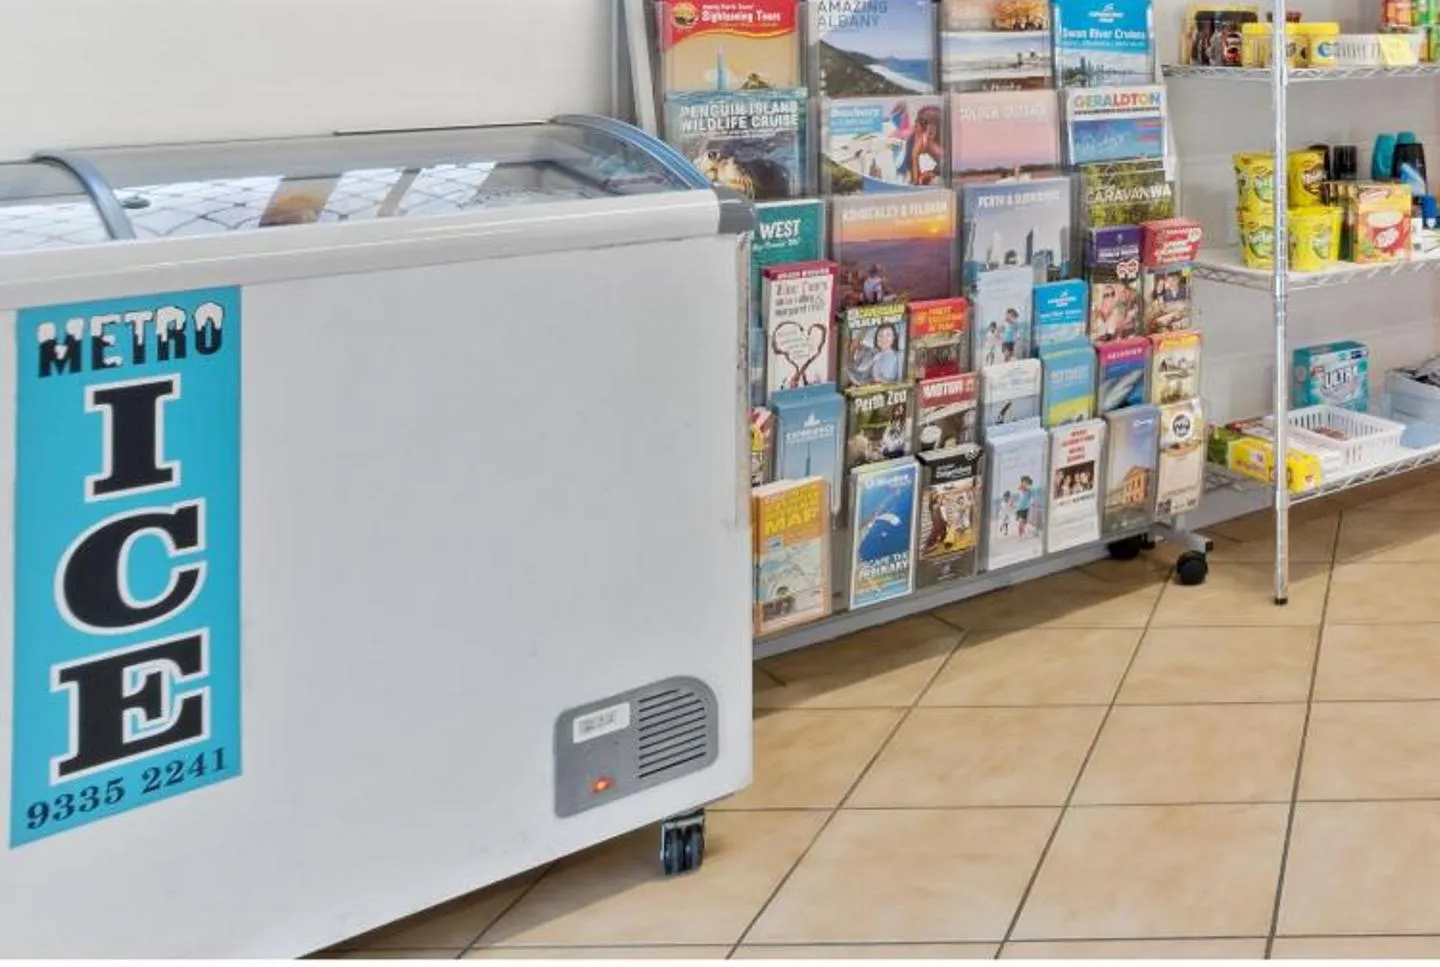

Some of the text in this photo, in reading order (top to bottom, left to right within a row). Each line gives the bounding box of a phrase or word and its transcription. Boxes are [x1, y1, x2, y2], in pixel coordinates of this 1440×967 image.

[817, 0, 889, 14] AMAZING
[817, 12, 882, 28] ALBANY
[680, 100, 798, 119] PENGUIN ISLAND
[1074, 91, 1162, 109] GERALDTON
[680, 114, 799, 133] WILDLIFE CRUISE
[759, 219, 801, 239] WEST
[37, 301, 225, 378] METRO
[886, 389, 908, 406] Zoo
[26, 745, 229, 831] 9335 2241
